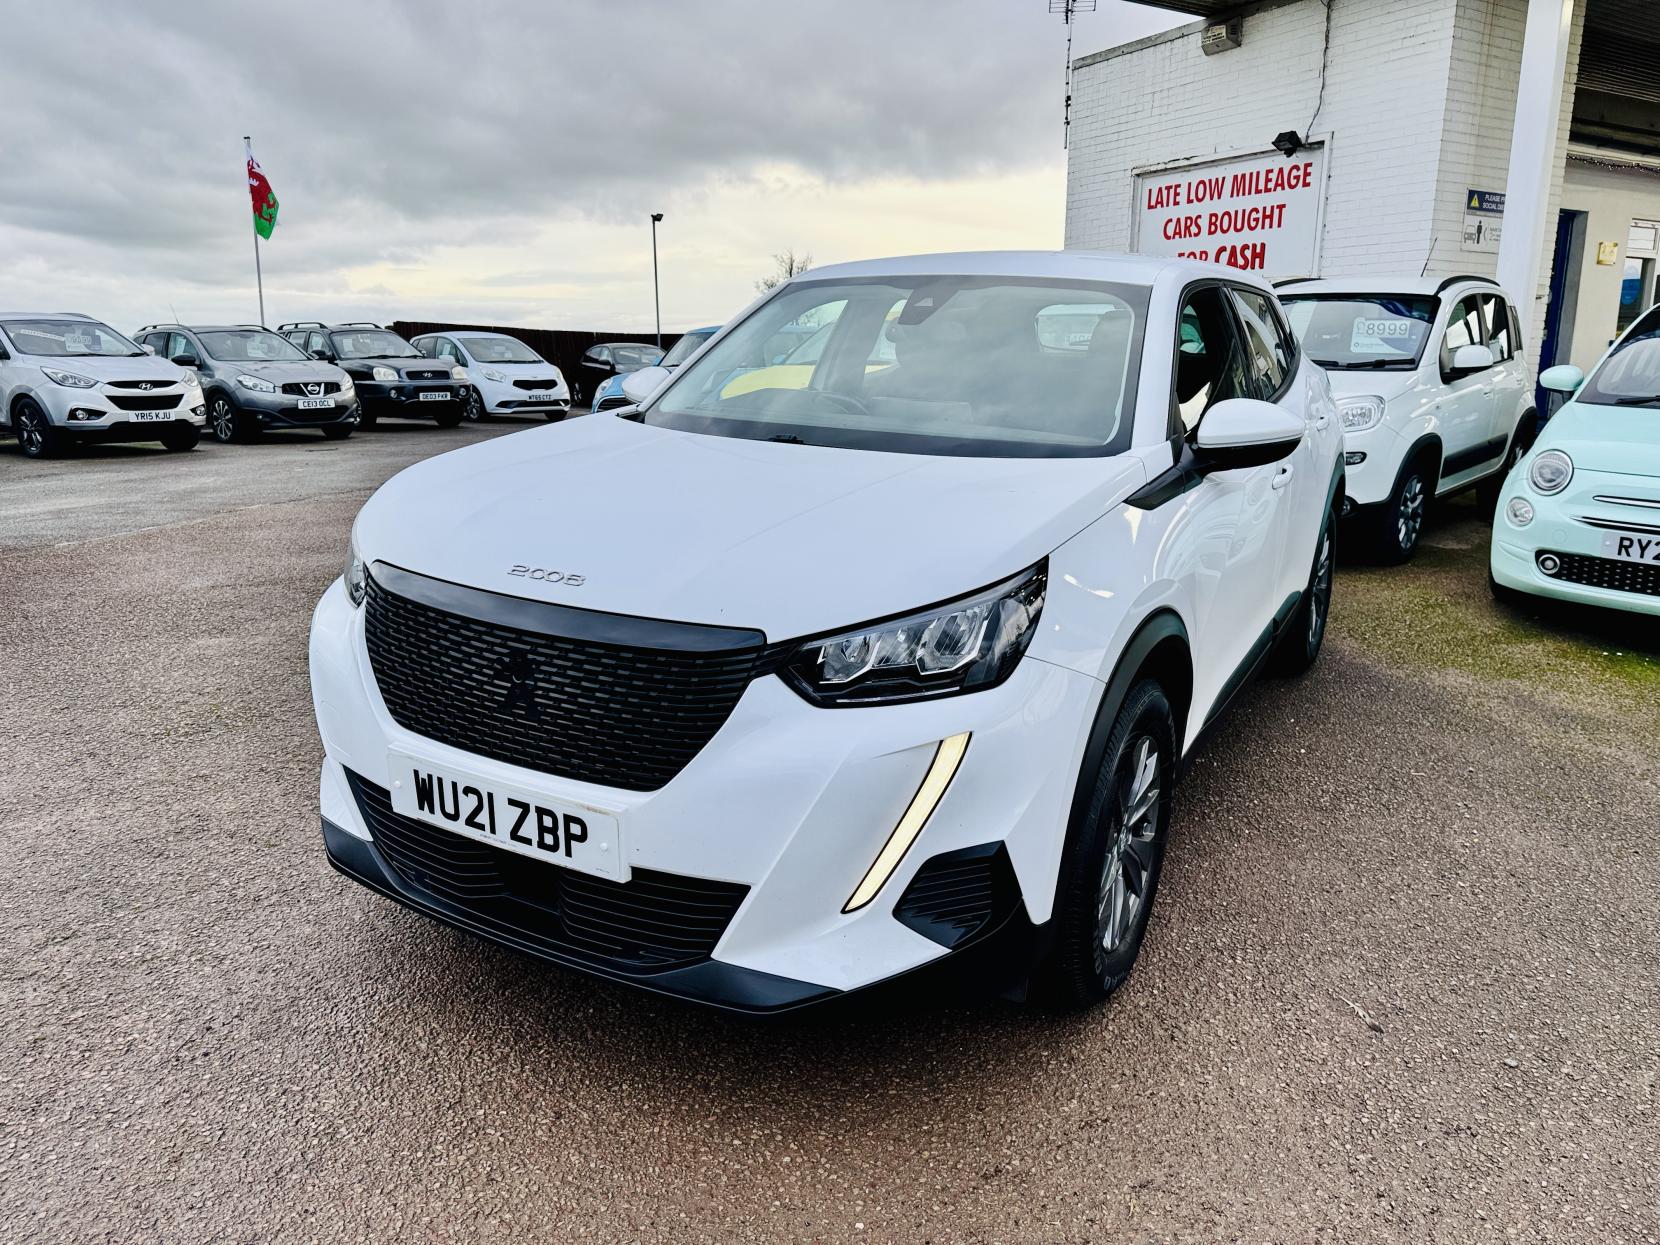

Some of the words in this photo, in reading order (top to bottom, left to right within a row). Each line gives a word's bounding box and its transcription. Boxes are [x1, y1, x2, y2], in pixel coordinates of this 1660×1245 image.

[1147, 183, 1182, 210] LATE
[1186, 176, 1226, 204] LOW
[1230, 162, 1313, 198] MILEAGE
[1485, 194, 1500, 202] PLEASE
[1163, 214, 1202, 241] CARS
[1207, 203, 1287, 236] BOUGHT
[1214, 242, 1266, 270] CASH
[134, 412, 154, 420] YR15
[155, 411, 171, 420] KJU
[507, 565, 586, 586] 2008
[413, 768, 497, 836] WU21
[507, 797, 589, 859] ZBP
